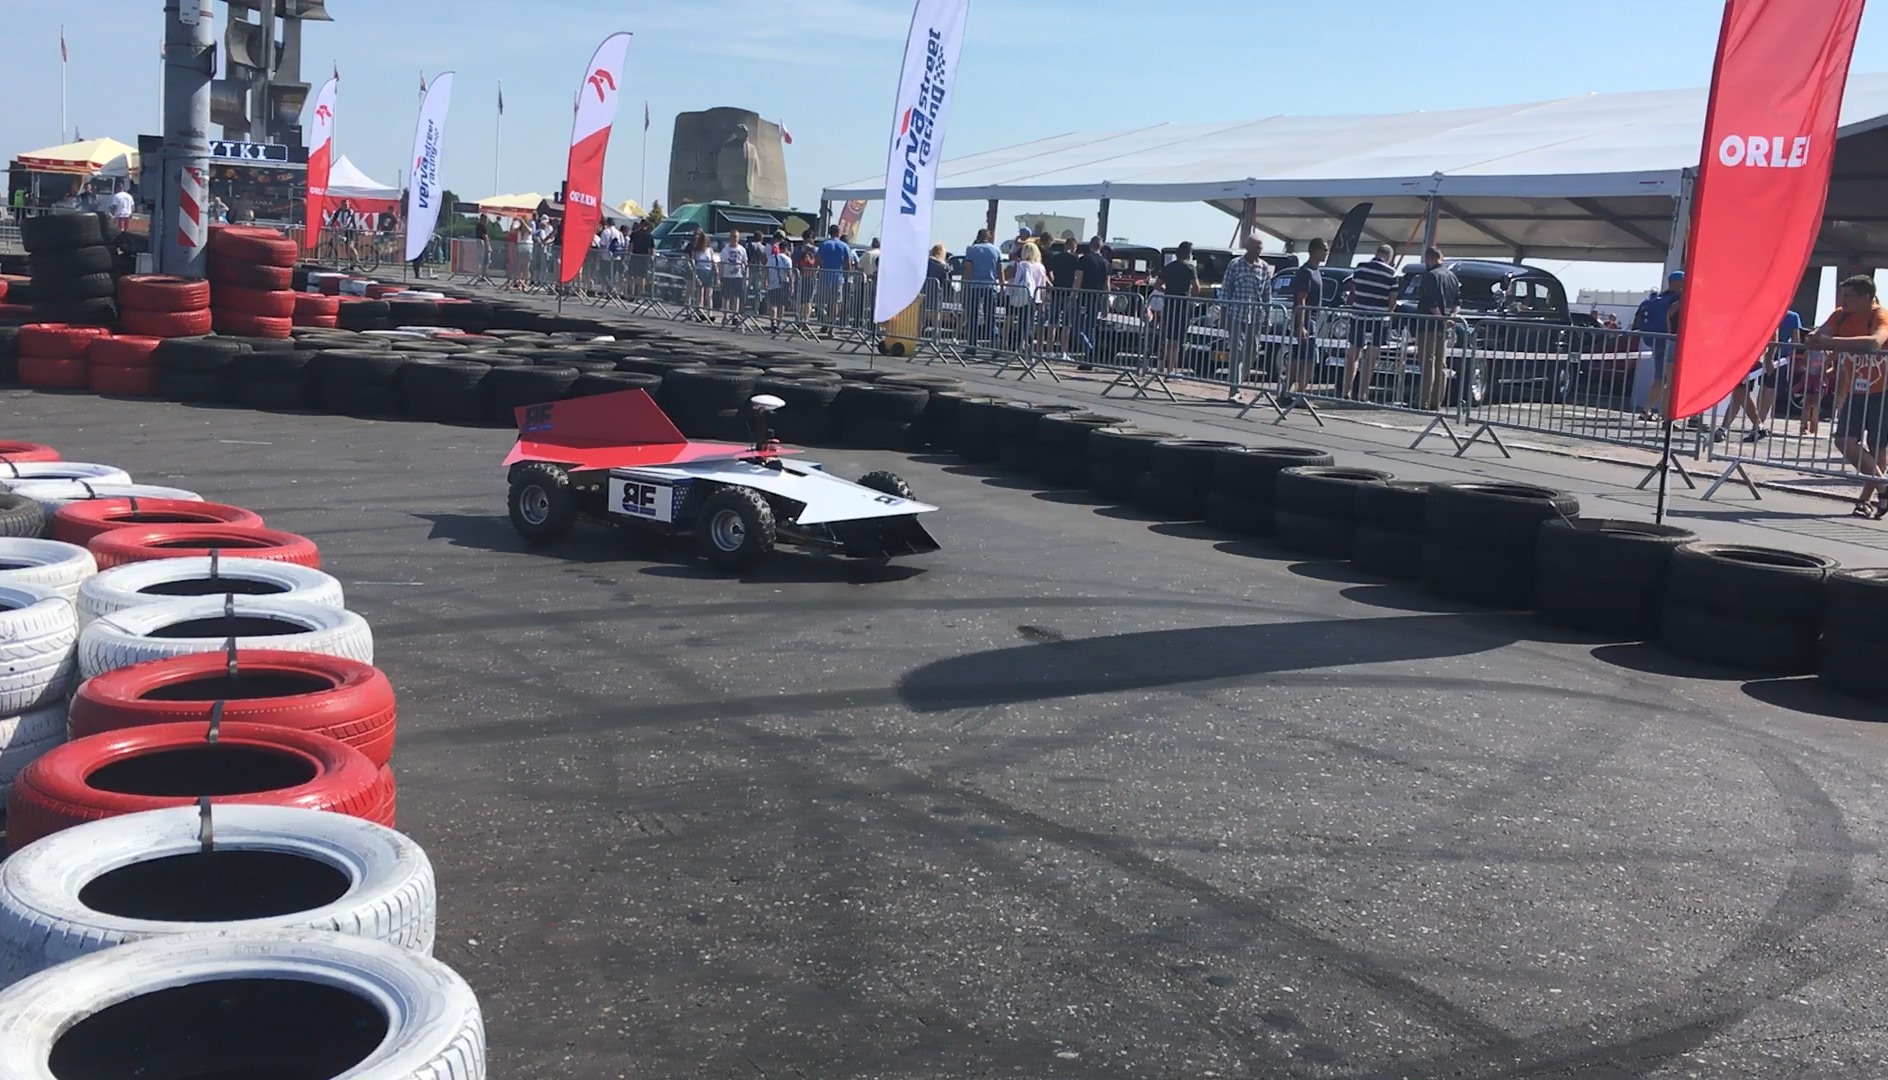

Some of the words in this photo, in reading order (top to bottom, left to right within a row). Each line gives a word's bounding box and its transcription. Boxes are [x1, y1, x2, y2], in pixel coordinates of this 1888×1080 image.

[900, 106, 926, 216] verva
[918, 27, 942, 110] street
[918, 84, 946, 168] racing
[1719, 134, 1811, 168] ORLE
[419, 157, 430, 209] verva
